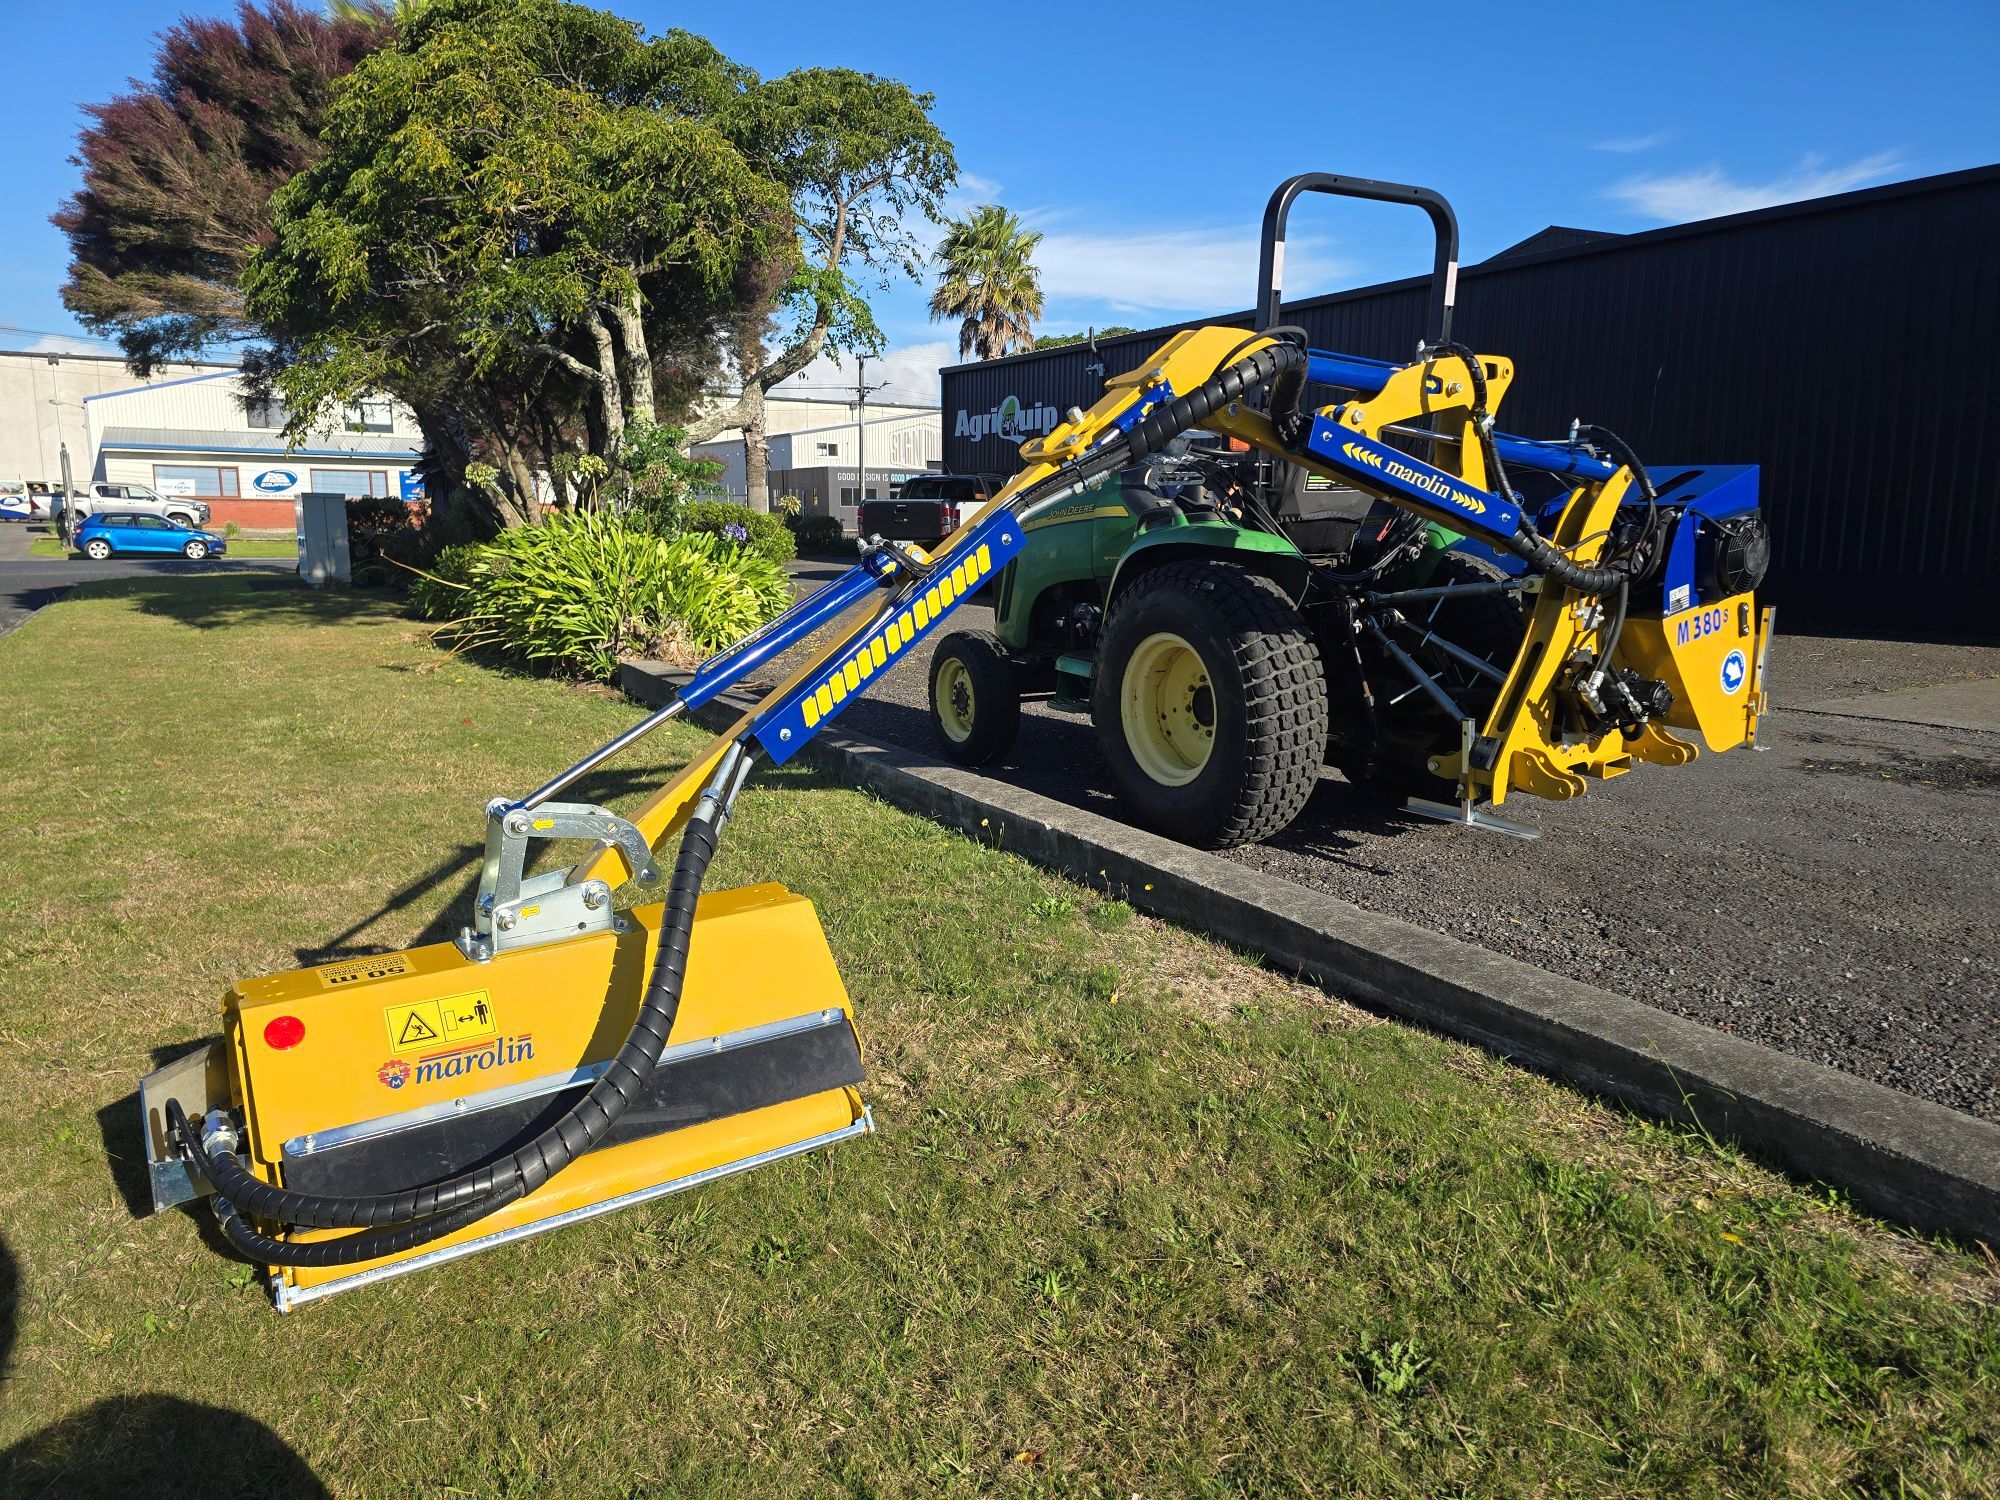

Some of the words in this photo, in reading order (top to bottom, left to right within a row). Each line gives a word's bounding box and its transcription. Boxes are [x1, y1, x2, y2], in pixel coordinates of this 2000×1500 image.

[955, 395, 1058, 445] AgriQuip
[837, 472, 856, 481] GOOD
[857, 473, 881, 482] SIGN
[882, 473, 889, 482] IS
[890, 473, 906, 482] GOOD
[1384, 461, 1451, 498] marolin
[1067, 504, 1095, 515] DEERE
[1677, 620, 1690, 646] M
[367, 966, 405, 978] 50
[415, 1037, 535, 1085] marolin
